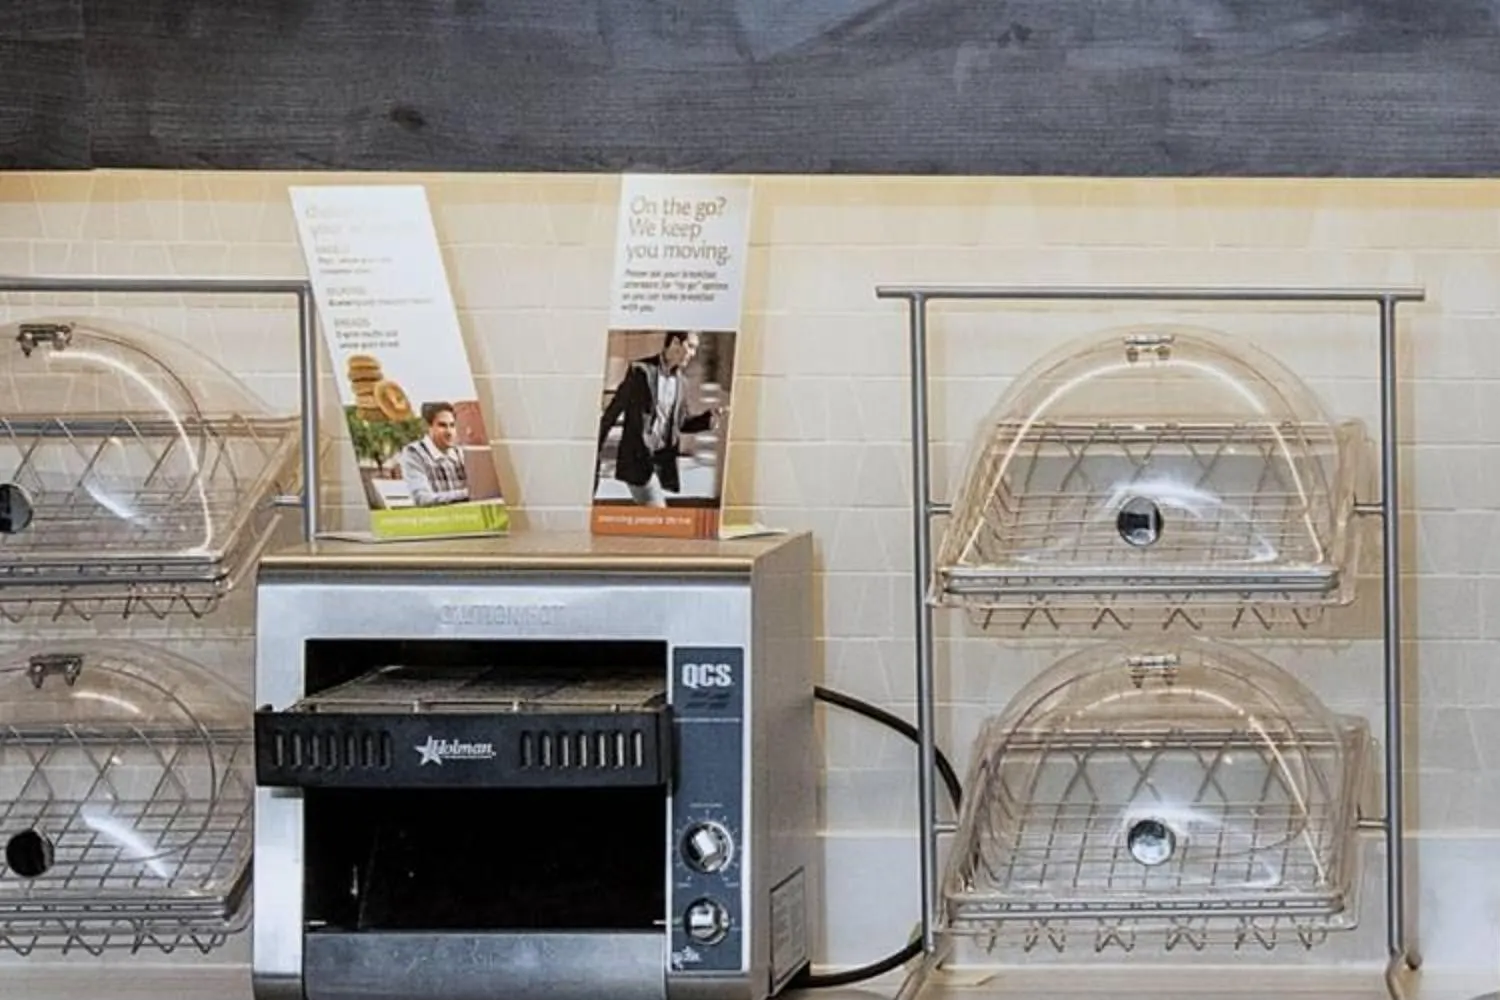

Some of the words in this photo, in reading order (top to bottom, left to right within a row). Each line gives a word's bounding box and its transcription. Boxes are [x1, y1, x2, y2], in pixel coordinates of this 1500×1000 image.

[630, 195, 657, 215] On
[663, 196, 691, 216] the
[694, 195, 727, 223] go?
[628, 216, 656, 237] We
[661, 217, 702, 242] keep
[625, 243, 659, 263] you
[681, 663, 733, 689] QCS
